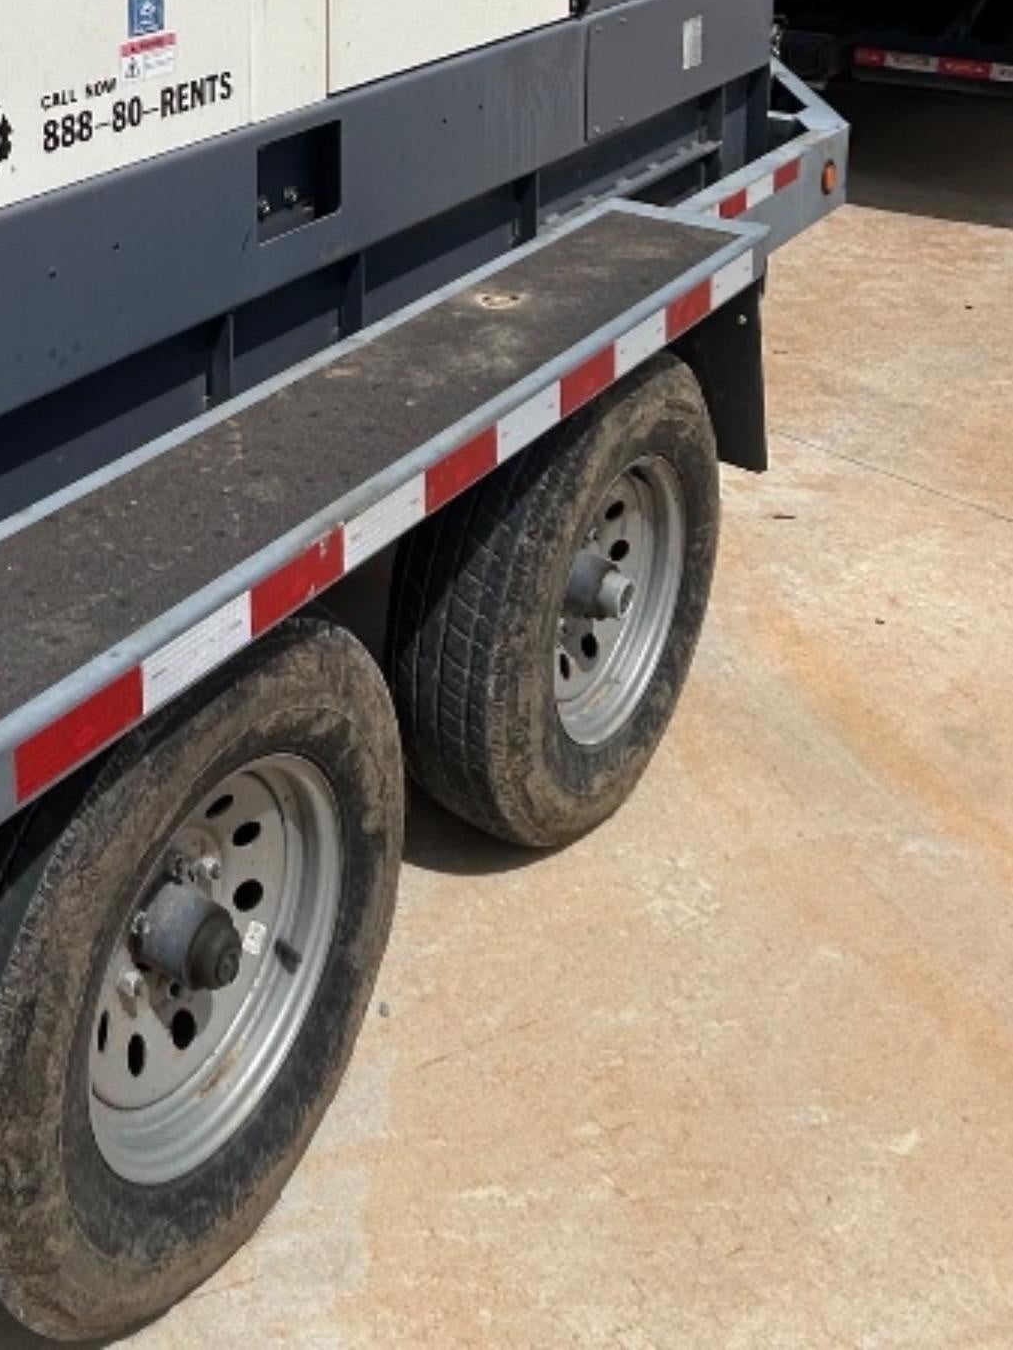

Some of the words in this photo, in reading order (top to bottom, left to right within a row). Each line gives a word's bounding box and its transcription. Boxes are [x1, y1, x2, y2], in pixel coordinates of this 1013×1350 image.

[41, 89, 78, 111] CALL
[85, 77, 118, 98] NOW
[43, 71, 234, 154] 888-80-RENTS
